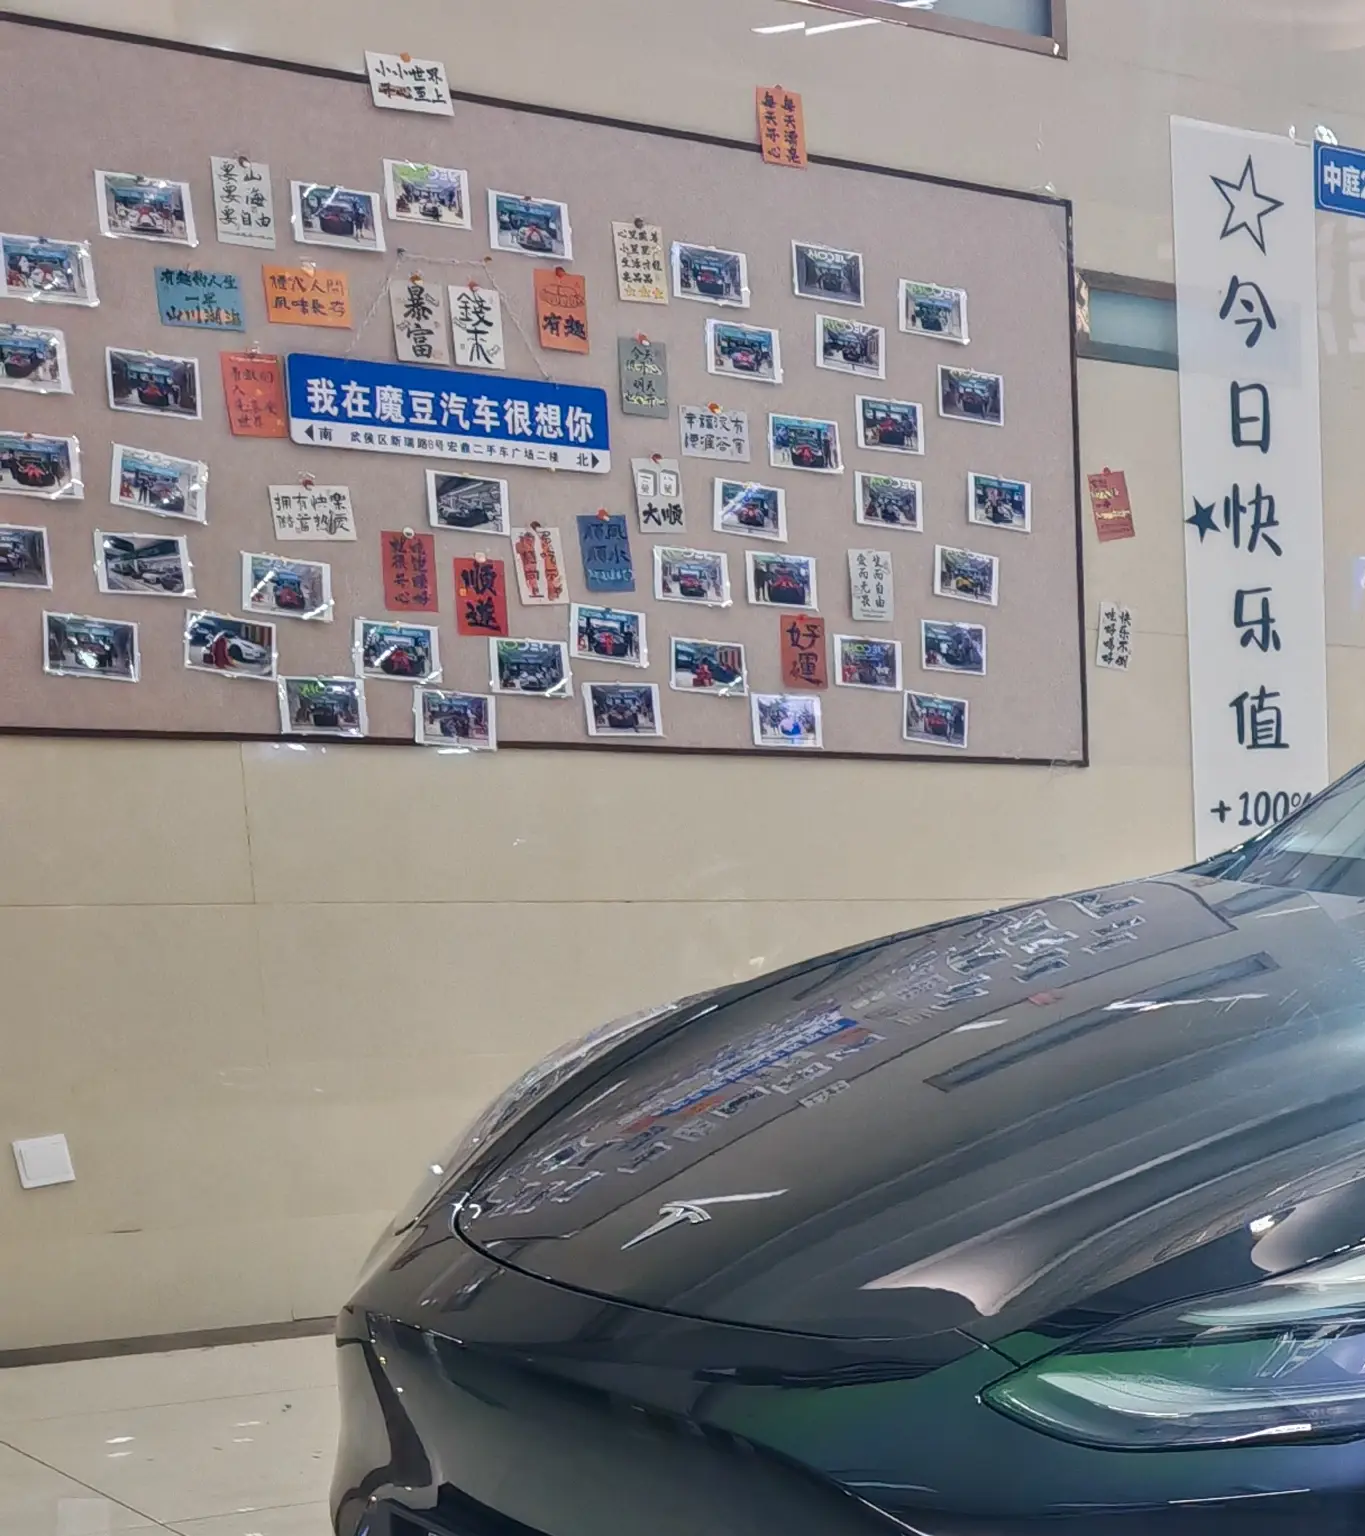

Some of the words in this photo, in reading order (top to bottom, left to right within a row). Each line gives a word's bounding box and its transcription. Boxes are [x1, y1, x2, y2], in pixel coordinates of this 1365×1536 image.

[404, 286, 434, 359] 暴富
[542, 314, 587, 340] 有趣
[305, 376, 594, 443] 我在魔豆汽车很想你
[318, 426, 333, 442] 南
[576, 453, 589, 468] 北
